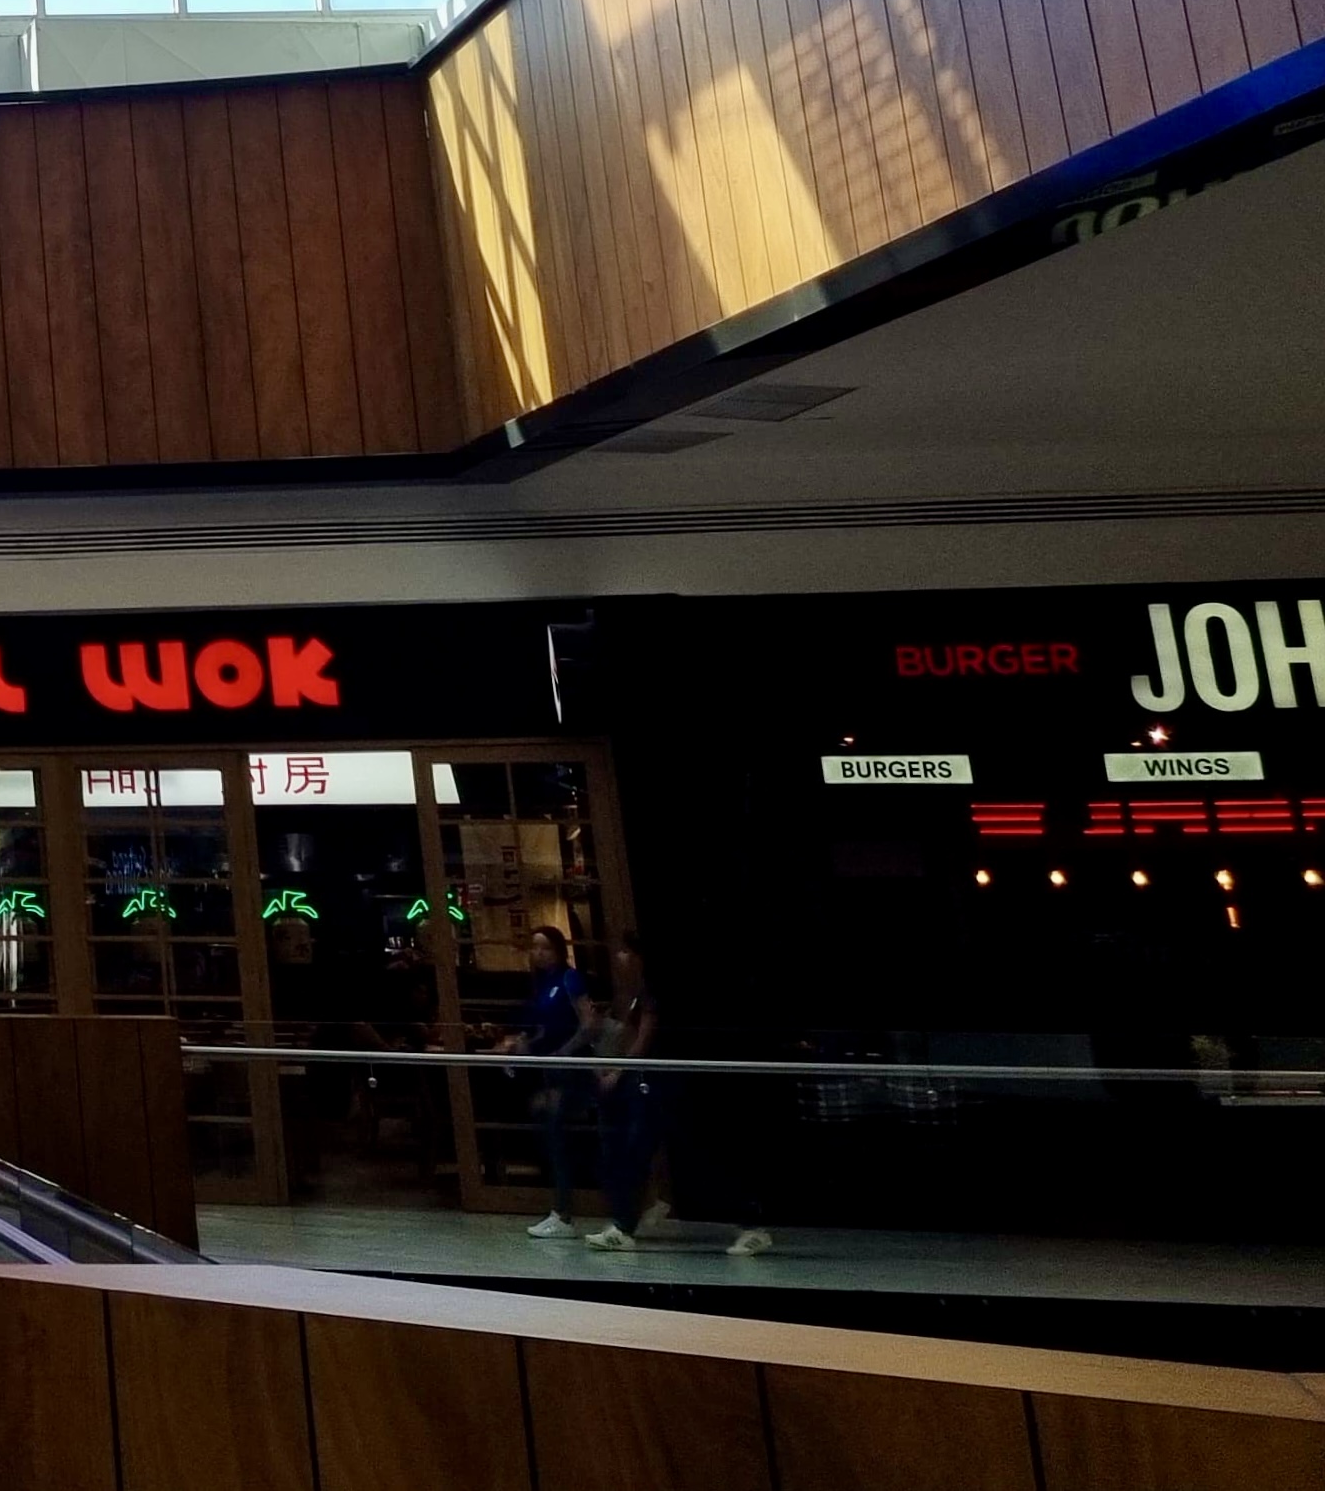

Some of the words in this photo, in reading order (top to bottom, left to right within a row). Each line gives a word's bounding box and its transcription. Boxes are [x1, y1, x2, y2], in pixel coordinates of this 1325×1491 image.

[81, 636, 339, 711] WOK
[894, 643, 1080, 678] BURGER
[839, 757, 953, 781] BURGERS
[1144, 756, 1231, 779] WINGS
